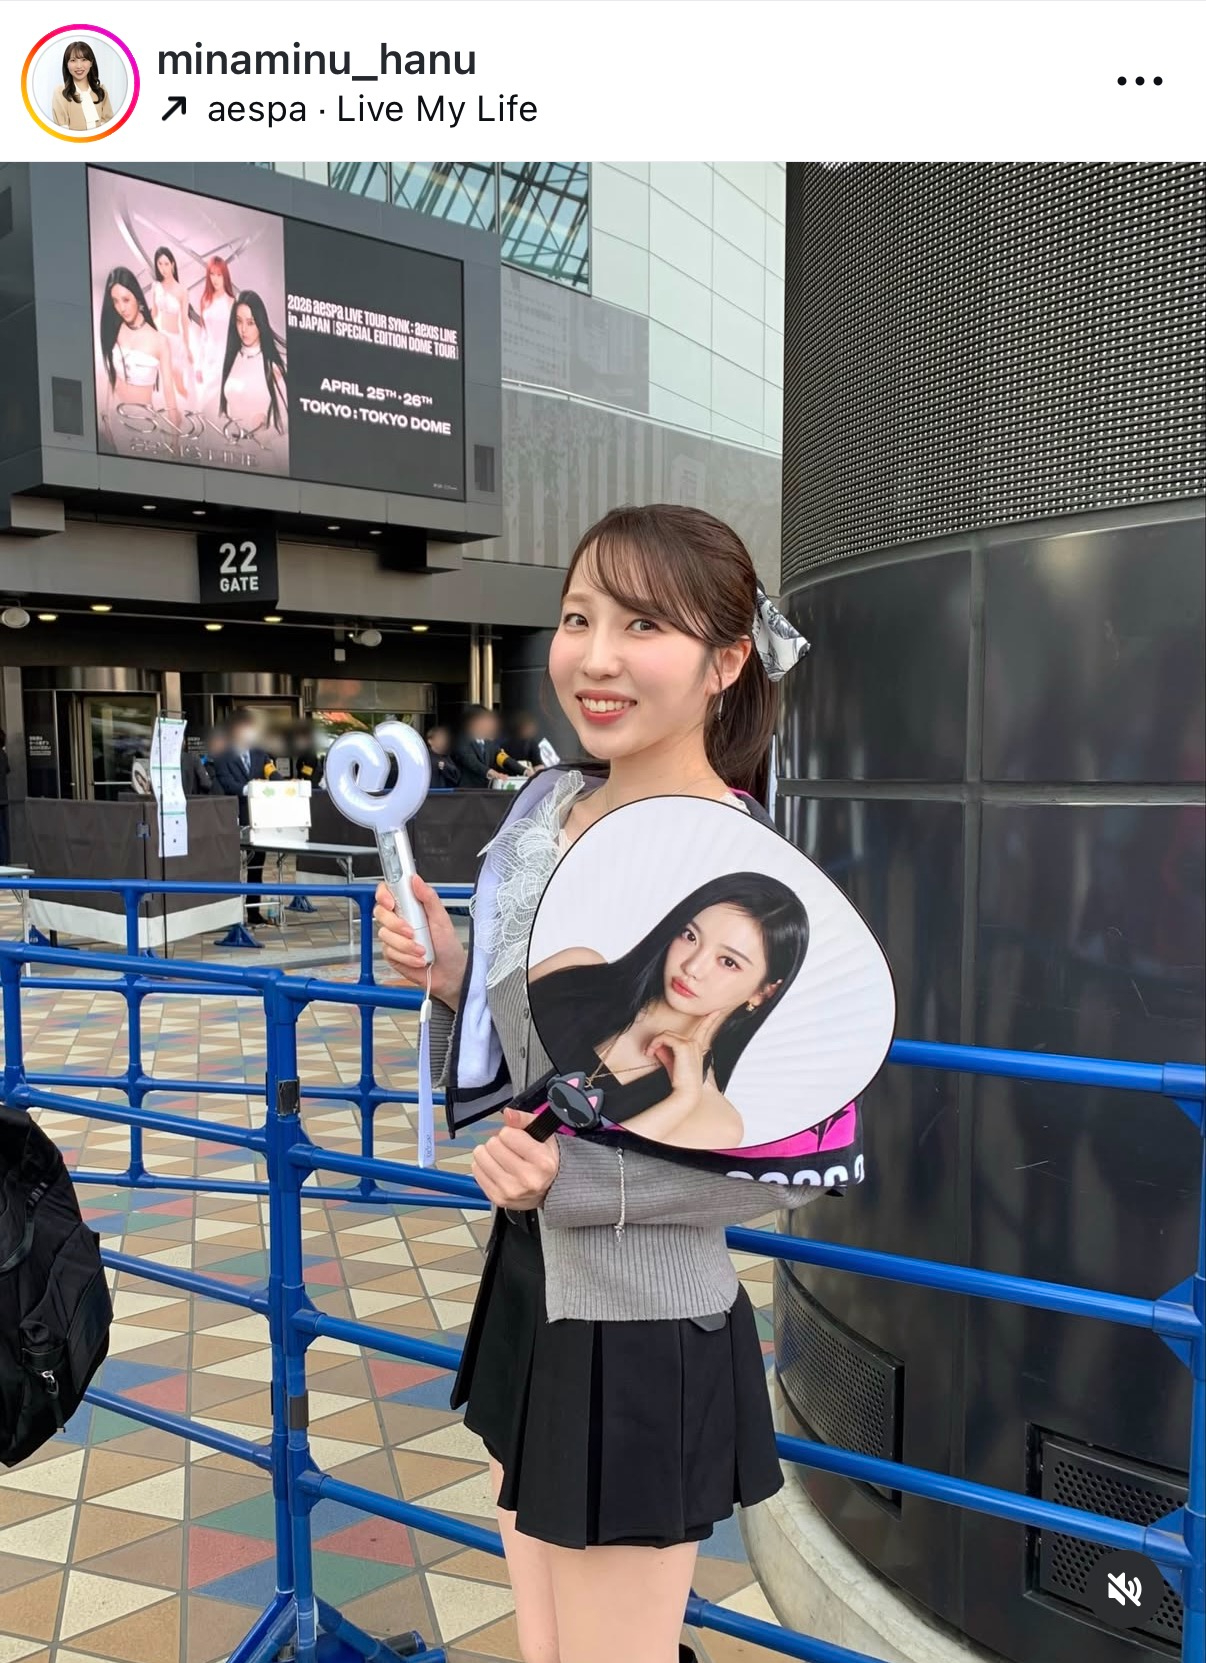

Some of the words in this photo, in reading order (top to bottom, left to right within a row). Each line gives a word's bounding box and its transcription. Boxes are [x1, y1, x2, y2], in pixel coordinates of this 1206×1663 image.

[287, 294, 312, 314] 2026
[344, 306, 364, 324] LIVE
[364, 310, 388, 330] TOUR
[388, 316, 411, 335] SYNK
[440, 327, 458, 345] LINE
[287, 311, 298, 328] in
[299, 313, 331, 334] JAPAN
[373, 328, 408, 350] EDITION
[408, 336, 433, 356] DOME
[320, 377, 364, 398] APRIL
[366, 385, 397, 402] 25TH
[402, 392, 433, 408] 26TH
[299, 397, 352, 419] TOKYO
[359, 407, 408, 429] TOKYO
[410, 416, 452, 436] DOME
[219, 541, 258, 574] 22
[220, 576, 259, 593] GATE
